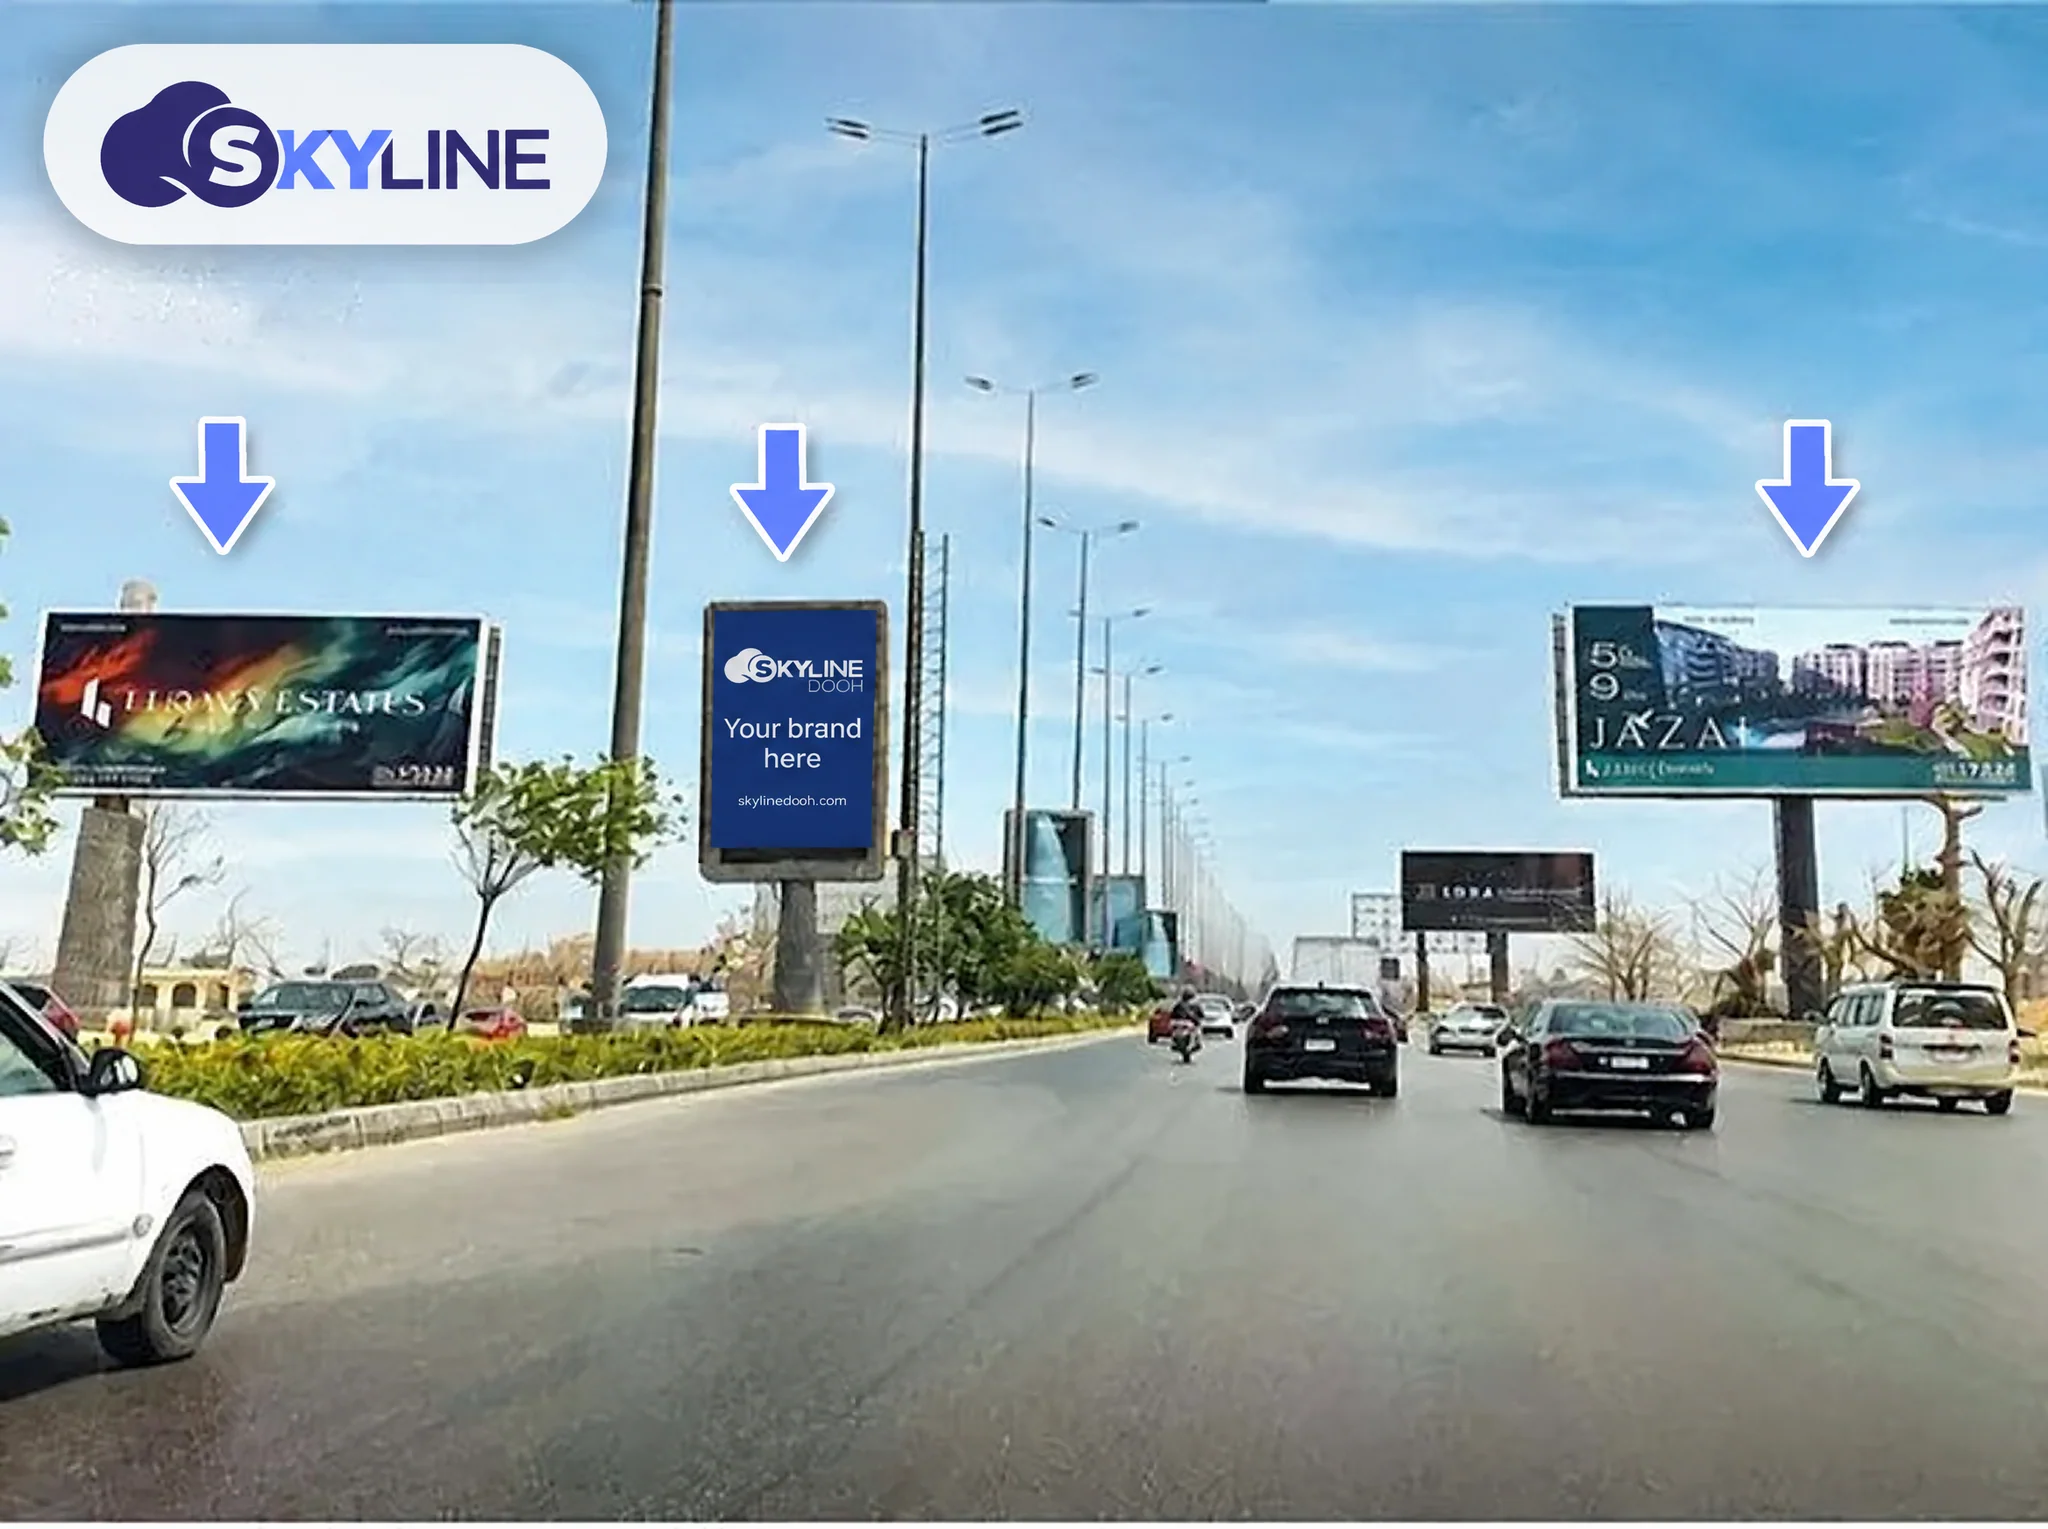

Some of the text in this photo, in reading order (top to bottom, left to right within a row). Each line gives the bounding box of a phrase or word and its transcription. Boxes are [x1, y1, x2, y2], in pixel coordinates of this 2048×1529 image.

[754, 659, 864, 678] SKYLINE
[808, 679, 864, 693] DOOH
[724, 717, 861, 739] Your brand
[764, 748, 821, 769] here
[738, 795, 847, 810] skylinedooh.com
